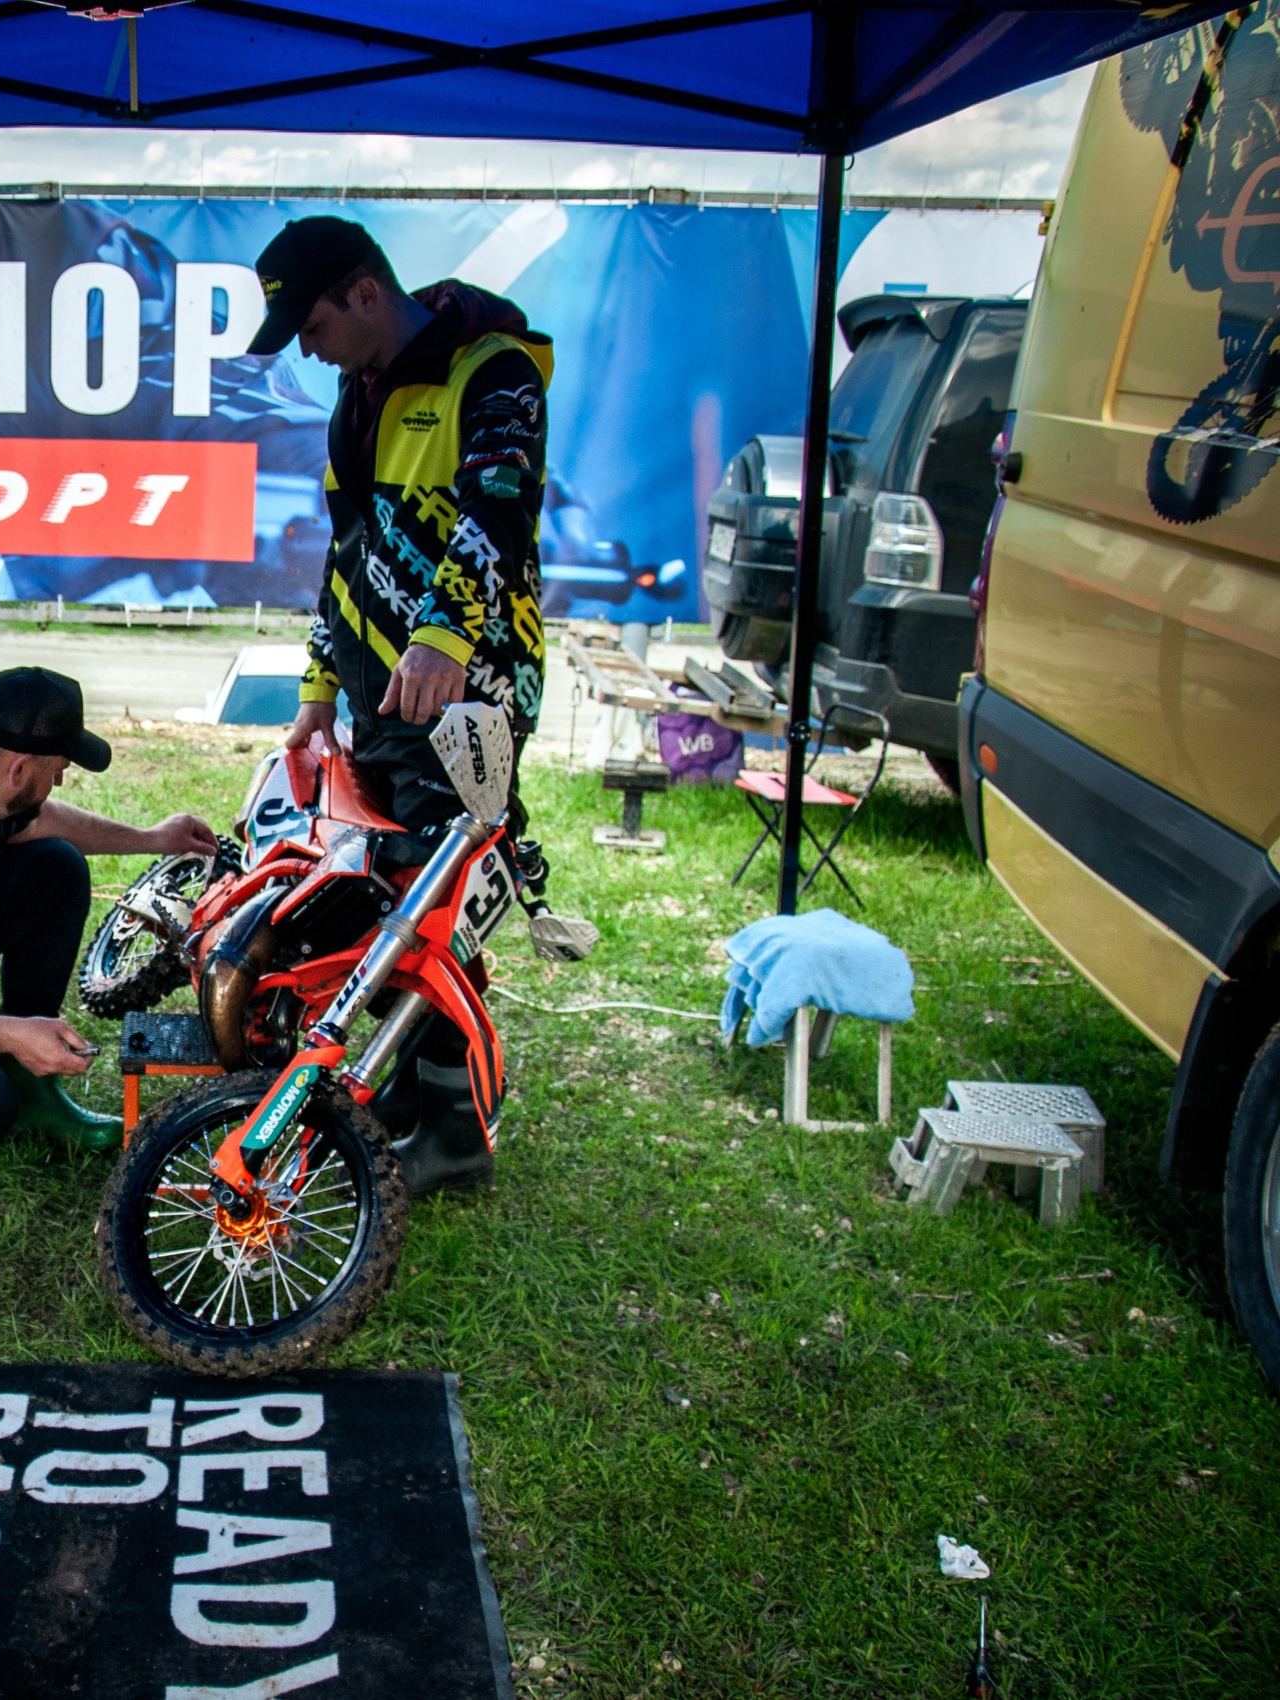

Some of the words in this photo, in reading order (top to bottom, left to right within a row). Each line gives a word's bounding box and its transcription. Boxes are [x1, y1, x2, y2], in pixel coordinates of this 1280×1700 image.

[677, 733, 714, 755] WB
[346, 995, 363, 1019] XACT
[255, 1085, 300, 1144] MOTOREX
[22, 1397, 175, 1505] TO
